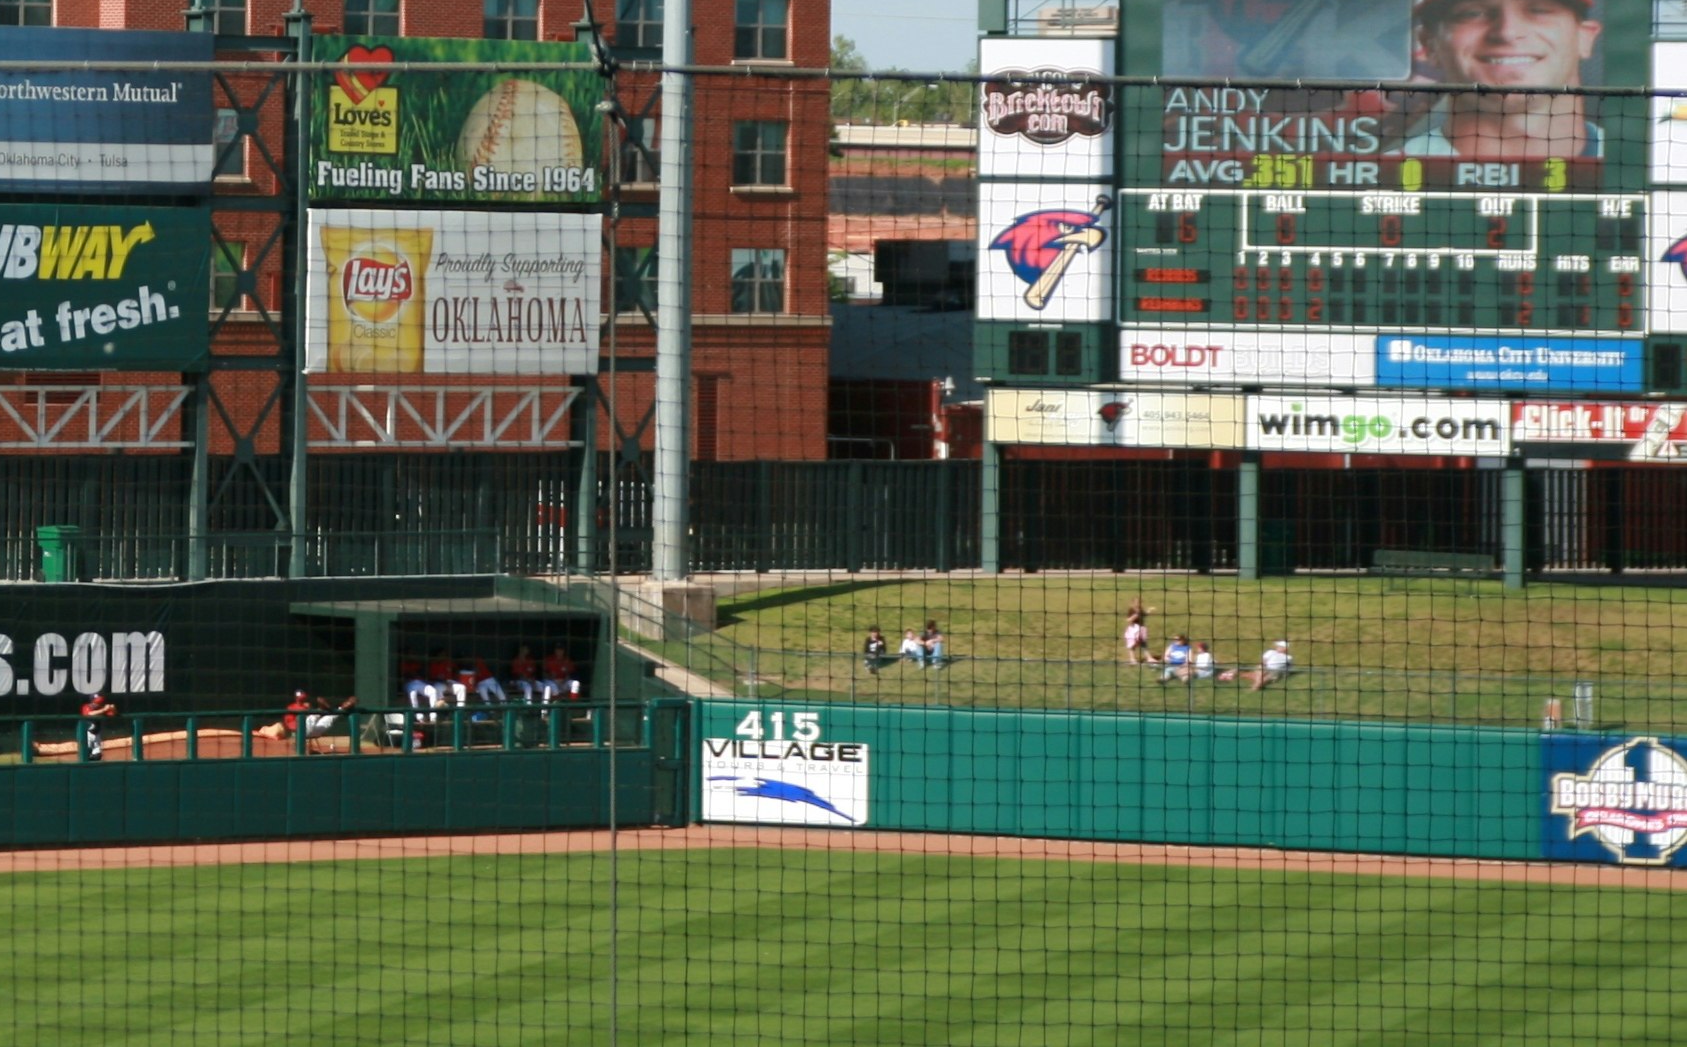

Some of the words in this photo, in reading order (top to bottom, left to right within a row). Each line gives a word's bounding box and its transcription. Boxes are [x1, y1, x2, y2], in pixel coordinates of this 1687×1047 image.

[112, 82, 178, 103] Mutual
[1165, 88, 1270, 115] ANDY
[1164, 116, 1379, 153] JENKINS
[58, 153, 81, 169] City
[100, 154, 128, 168] Tulsa
[1169, 160, 1243, 183] AVG
[1329, 161, 1380, 185] HR
[1458, 162, 1521, 186] RBI
[1544, 157, 1567, 192] 3
[317, 160, 402, 195] Fueling
[411, 163, 465, 191] Fans
[472, 165, 536, 192] Since
[543, 166, 595, 192] 1964
[1147, 194, 1169, 211] AT
[1172, 194, 1203, 211] BAT
[1265, 195, 1306, 213] BALL
[1362, 196, 1421, 215] STRIKE
[1479, 197, 1516, 216] OUT
[1487, 216, 1507, 248] 2
[435, 253, 497, 282] Proudly
[500, 254, 584, 283] Supporting
[1236, 252, 1248, 265] 1
[1257, 252, 1269, 266] 2
[1280, 252, 1293, 266] 3
[1309, 252, 1321, 267] 4
[1331, 253, 1343, 267] 5
[1354, 253, 1366, 267] 6
[1384, 253, 1395, 267] 7
[1407, 253, 1417, 268] 8
[1428, 253, 1440, 268] 9
[1457, 254, 1474, 269] 10
[1497, 255, 1536, 271] RUNS
[1557, 255, 1590, 272] HITS
[347, 259, 409, 301] Lay's
[56, 286, 179, 342] fresh.
[432, 296, 587, 343] OKLAHOMA
[353, 323, 397, 339] Classic
[1130, 344, 1223, 367] BOLDT
[1414, 345, 1496, 363] OKLAHOMA
[1498, 345, 1533, 364] CITY
[1259, 402, 1500, 443] wimgo.com
[736, 710, 821, 742] 415
[706, 740, 862, 762] VILLAGE
[706, 760, 765, 771] TOURS
[797, 763, 863, 773] TRAVEL
